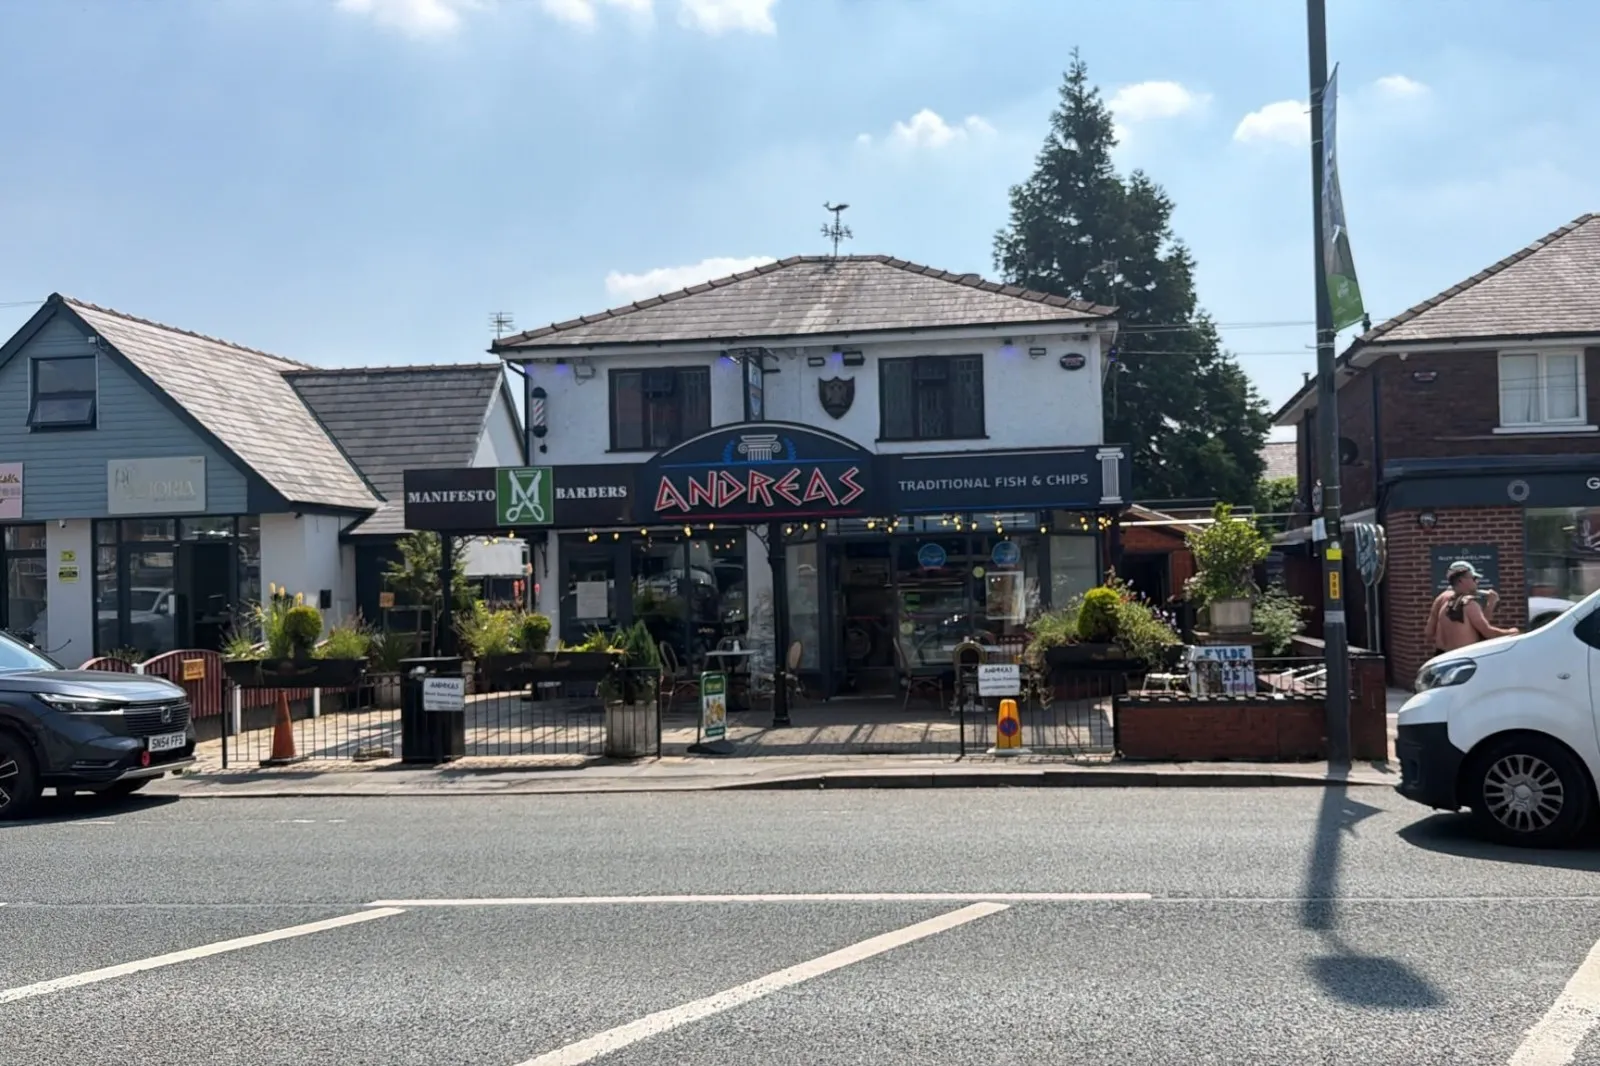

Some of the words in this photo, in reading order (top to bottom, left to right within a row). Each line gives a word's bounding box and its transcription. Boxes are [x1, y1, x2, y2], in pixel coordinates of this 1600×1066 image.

[654, 467, 865, 512] ANDREAS
[898, 477, 991, 491] TRADITIONAL
[995, 476, 1027, 488] FISH
[1031, 475, 1042, 486] &
[1046, 473, 1089, 486] CHIPS
[408, 489, 496, 504] MANIFESTO
[555, 485, 628, 500] BARBERS
[1204, 648, 1247, 660] FYLDE
